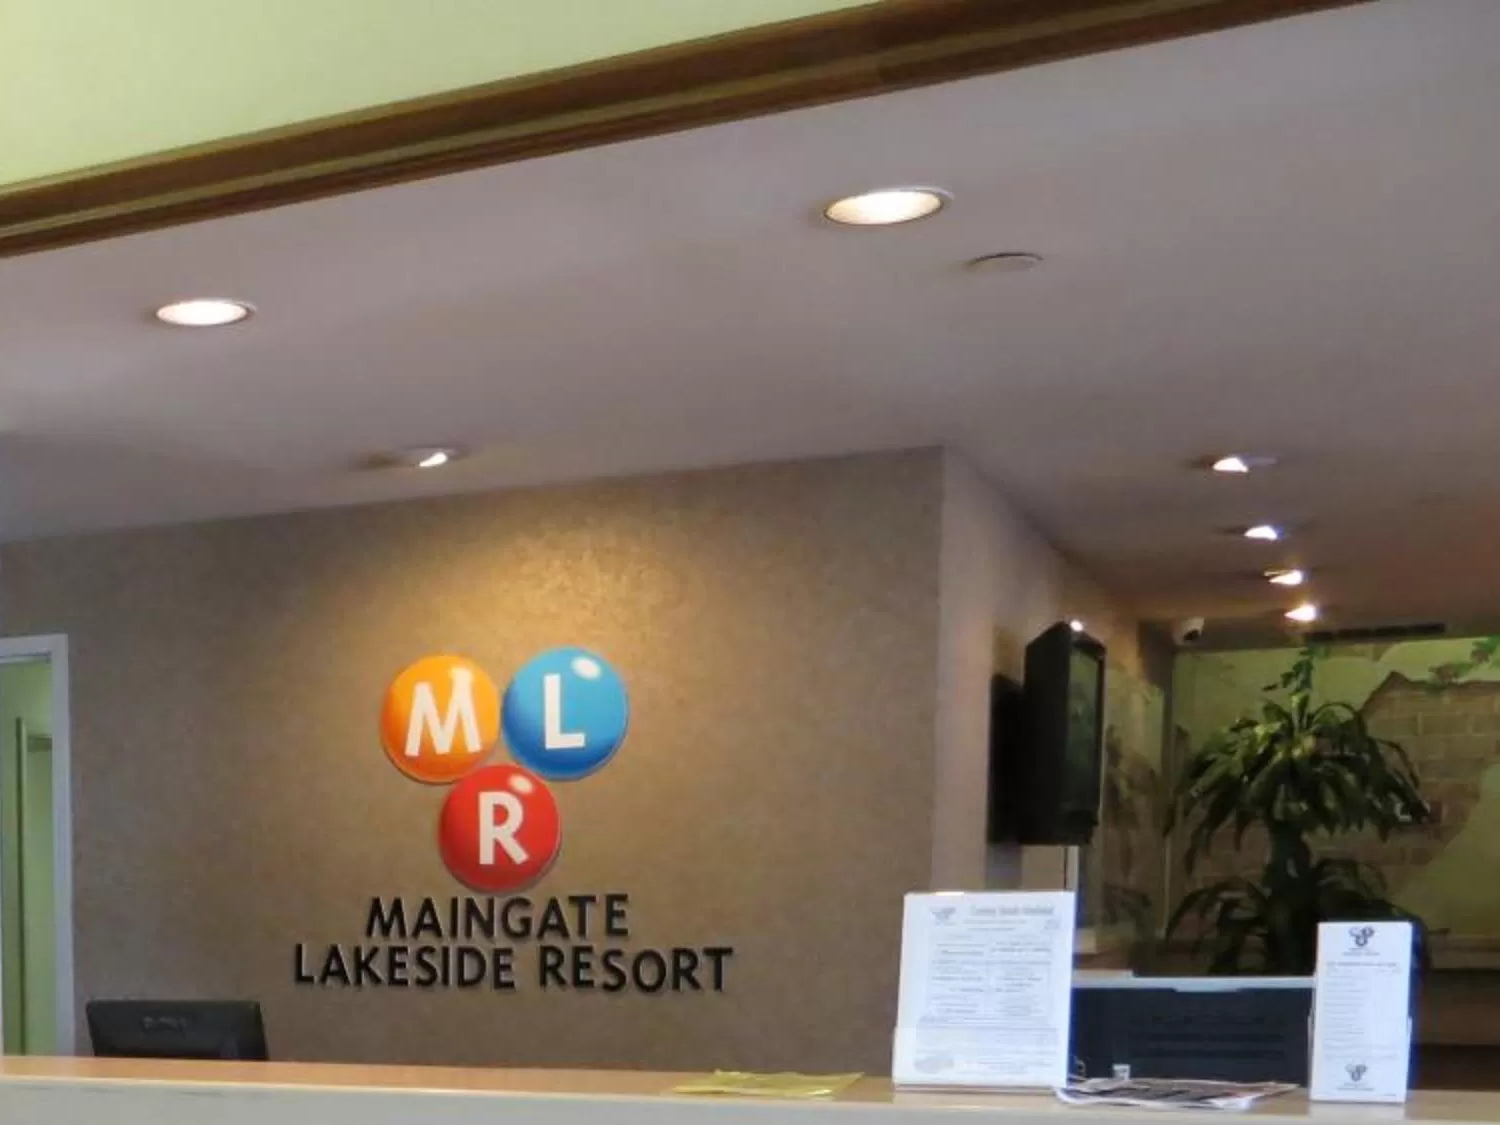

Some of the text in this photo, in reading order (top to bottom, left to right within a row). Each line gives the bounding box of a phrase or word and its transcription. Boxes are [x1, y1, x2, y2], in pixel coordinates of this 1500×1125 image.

[404, 667, 586, 758] M L
[478, 791, 530, 866] R
[365, 893, 630, 940] MAINGATE
[293, 942, 734, 993] LAKESIDE RESORT
